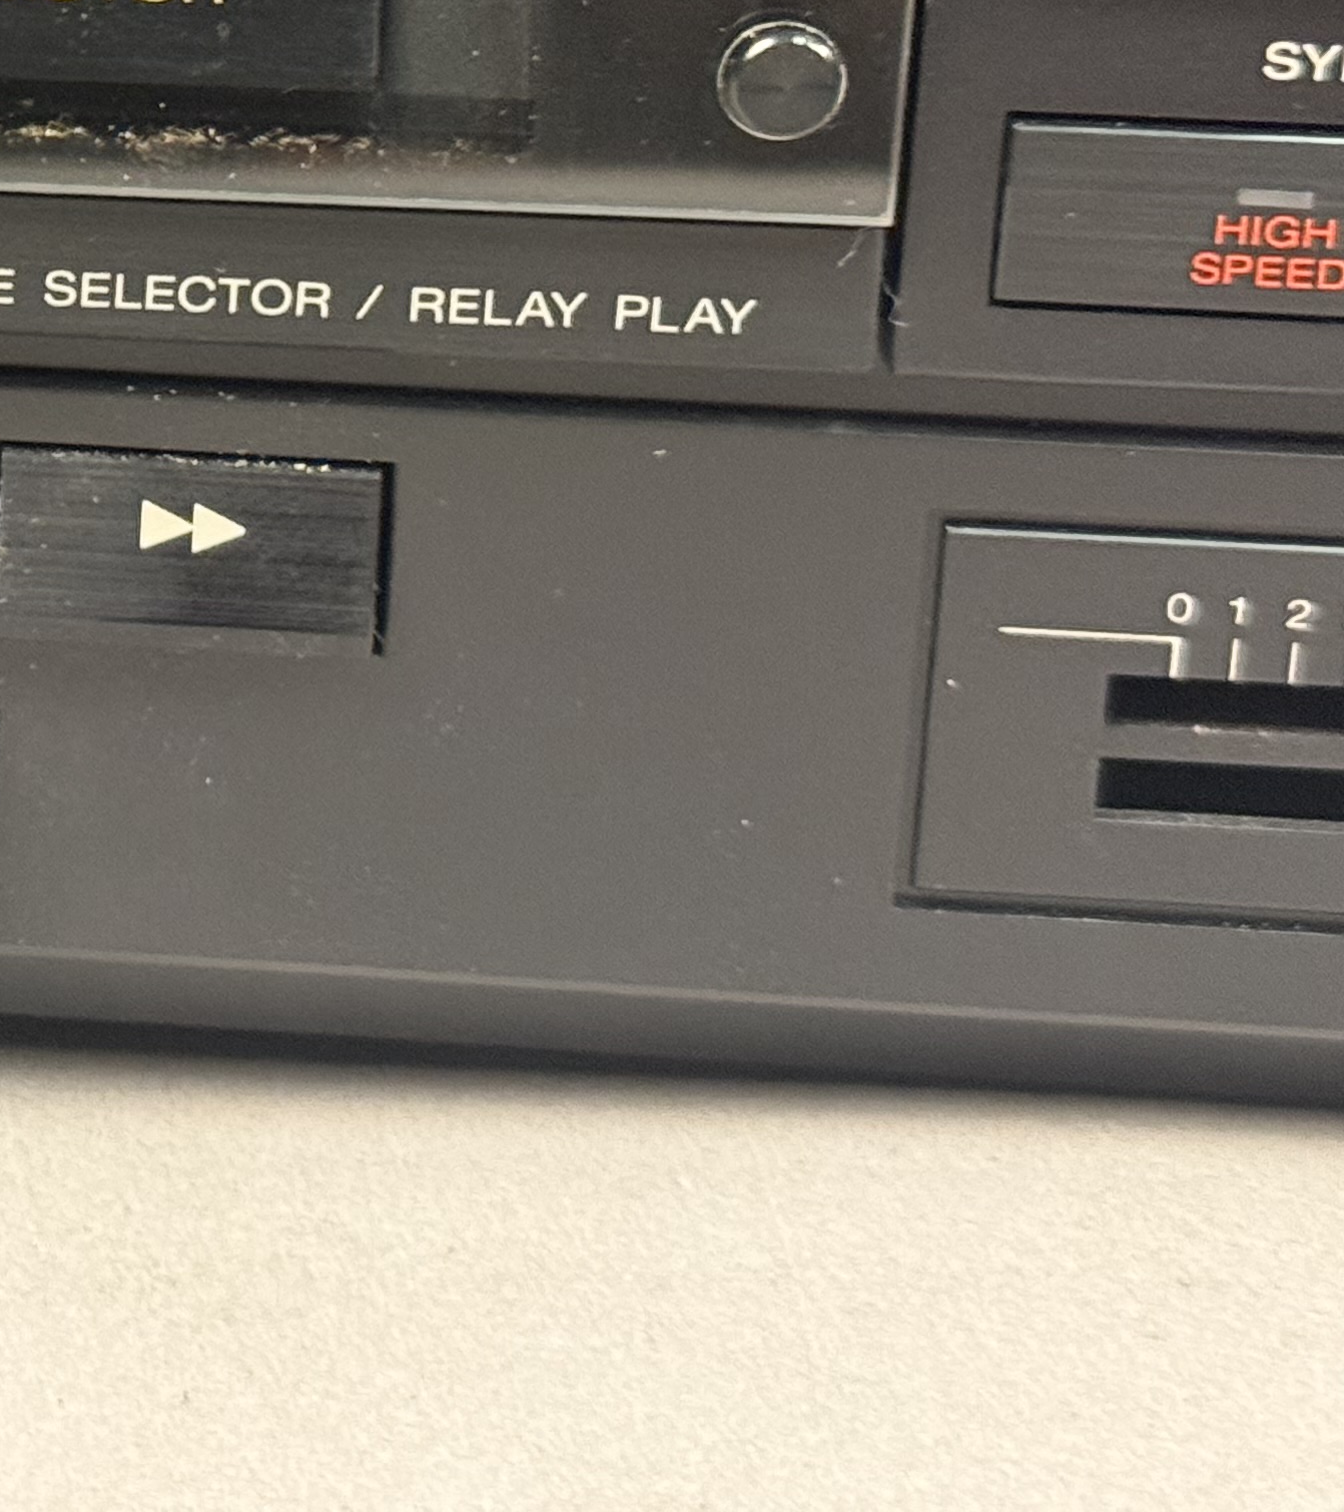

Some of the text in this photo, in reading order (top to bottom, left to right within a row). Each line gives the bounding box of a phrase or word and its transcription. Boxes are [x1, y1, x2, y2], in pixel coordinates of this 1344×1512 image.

[1262, 41, 1344, 82] SY
[1214, 215, 1338, 250] HIGH
[1189, 252, 1344, 291] SPEED
[42, 268, 332, 319] SELECTOR
[355, 283, 385, 321] /
[408, 285, 590, 329] RELAY
[613, 293, 759, 336] PLAY
[1166, 592, 1313, 630] 0 1 2
